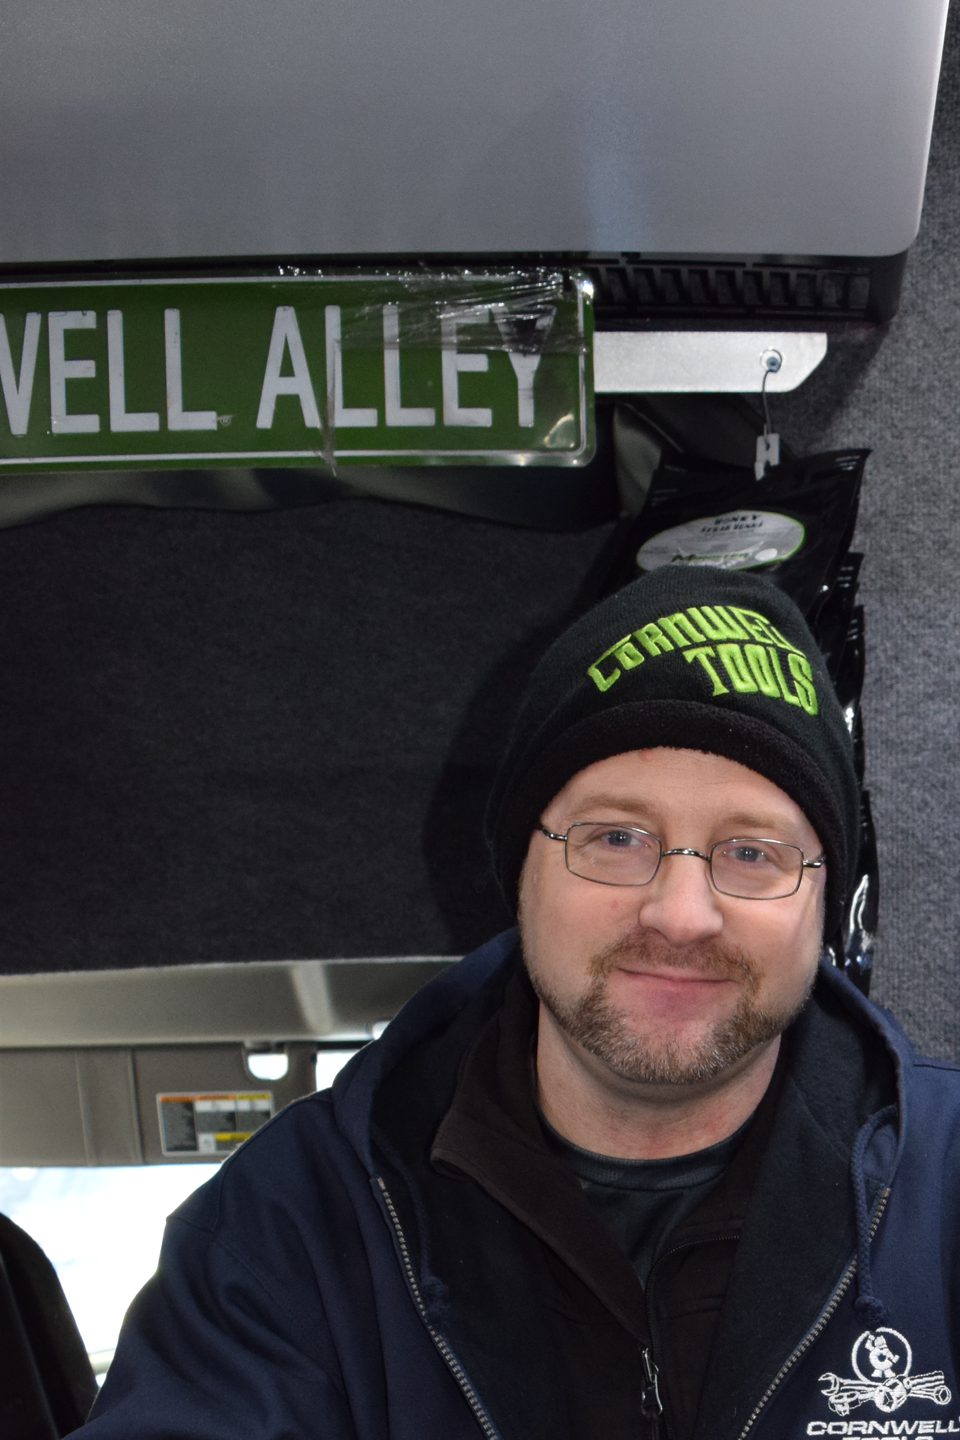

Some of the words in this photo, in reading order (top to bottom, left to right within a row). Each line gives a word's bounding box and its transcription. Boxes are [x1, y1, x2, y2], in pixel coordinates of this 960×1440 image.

[256, 305, 556, 429] ALLEY
[682, 642, 819, 716] TOOLS
[806, 1420, 960, 1436] CORNWELL
